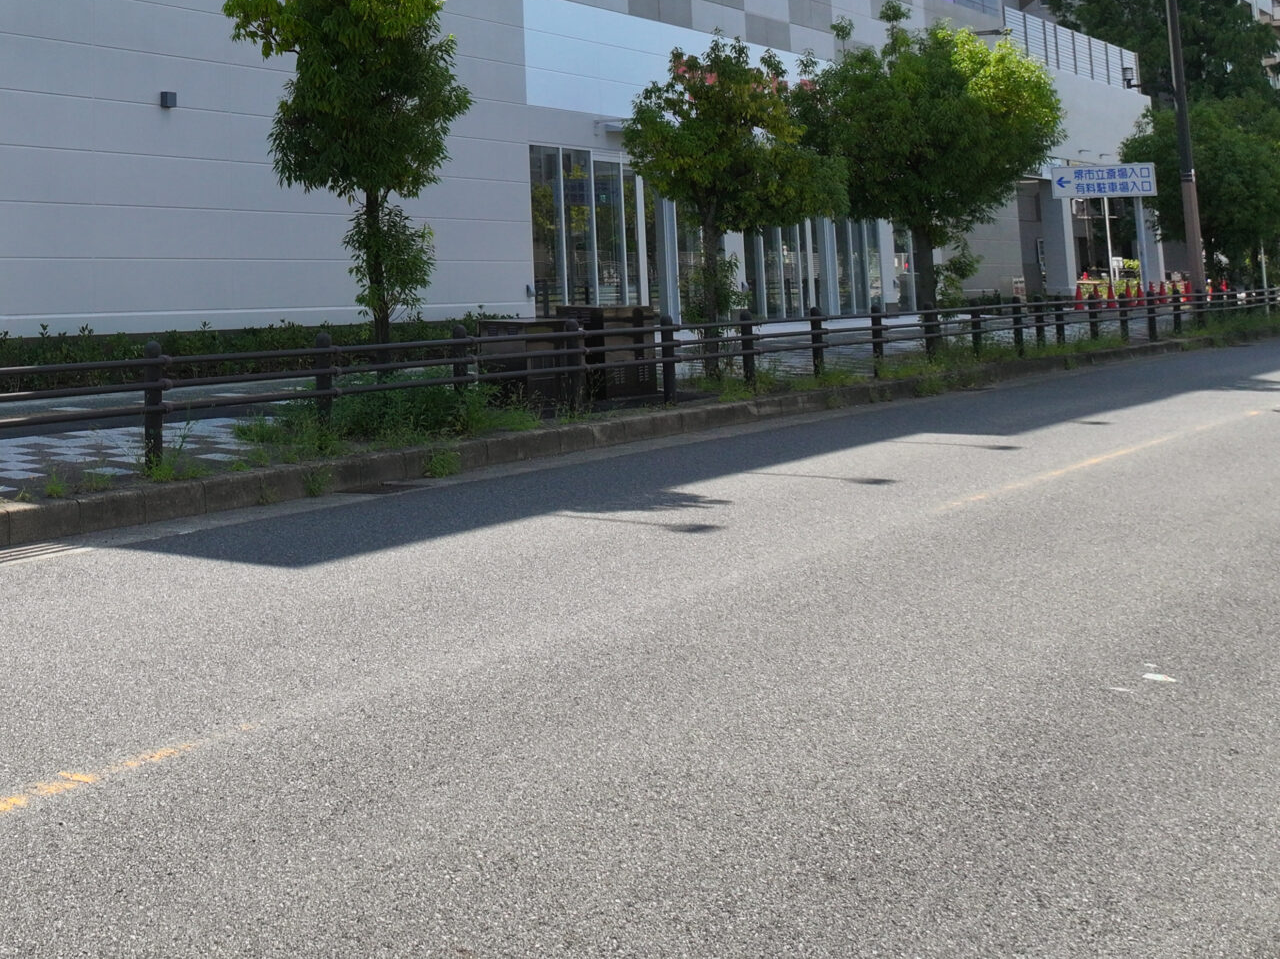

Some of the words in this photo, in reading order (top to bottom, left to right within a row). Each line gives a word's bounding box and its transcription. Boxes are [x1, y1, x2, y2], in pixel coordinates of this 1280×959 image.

[1075, 181, 1152, 194] 有料駐車場入口
